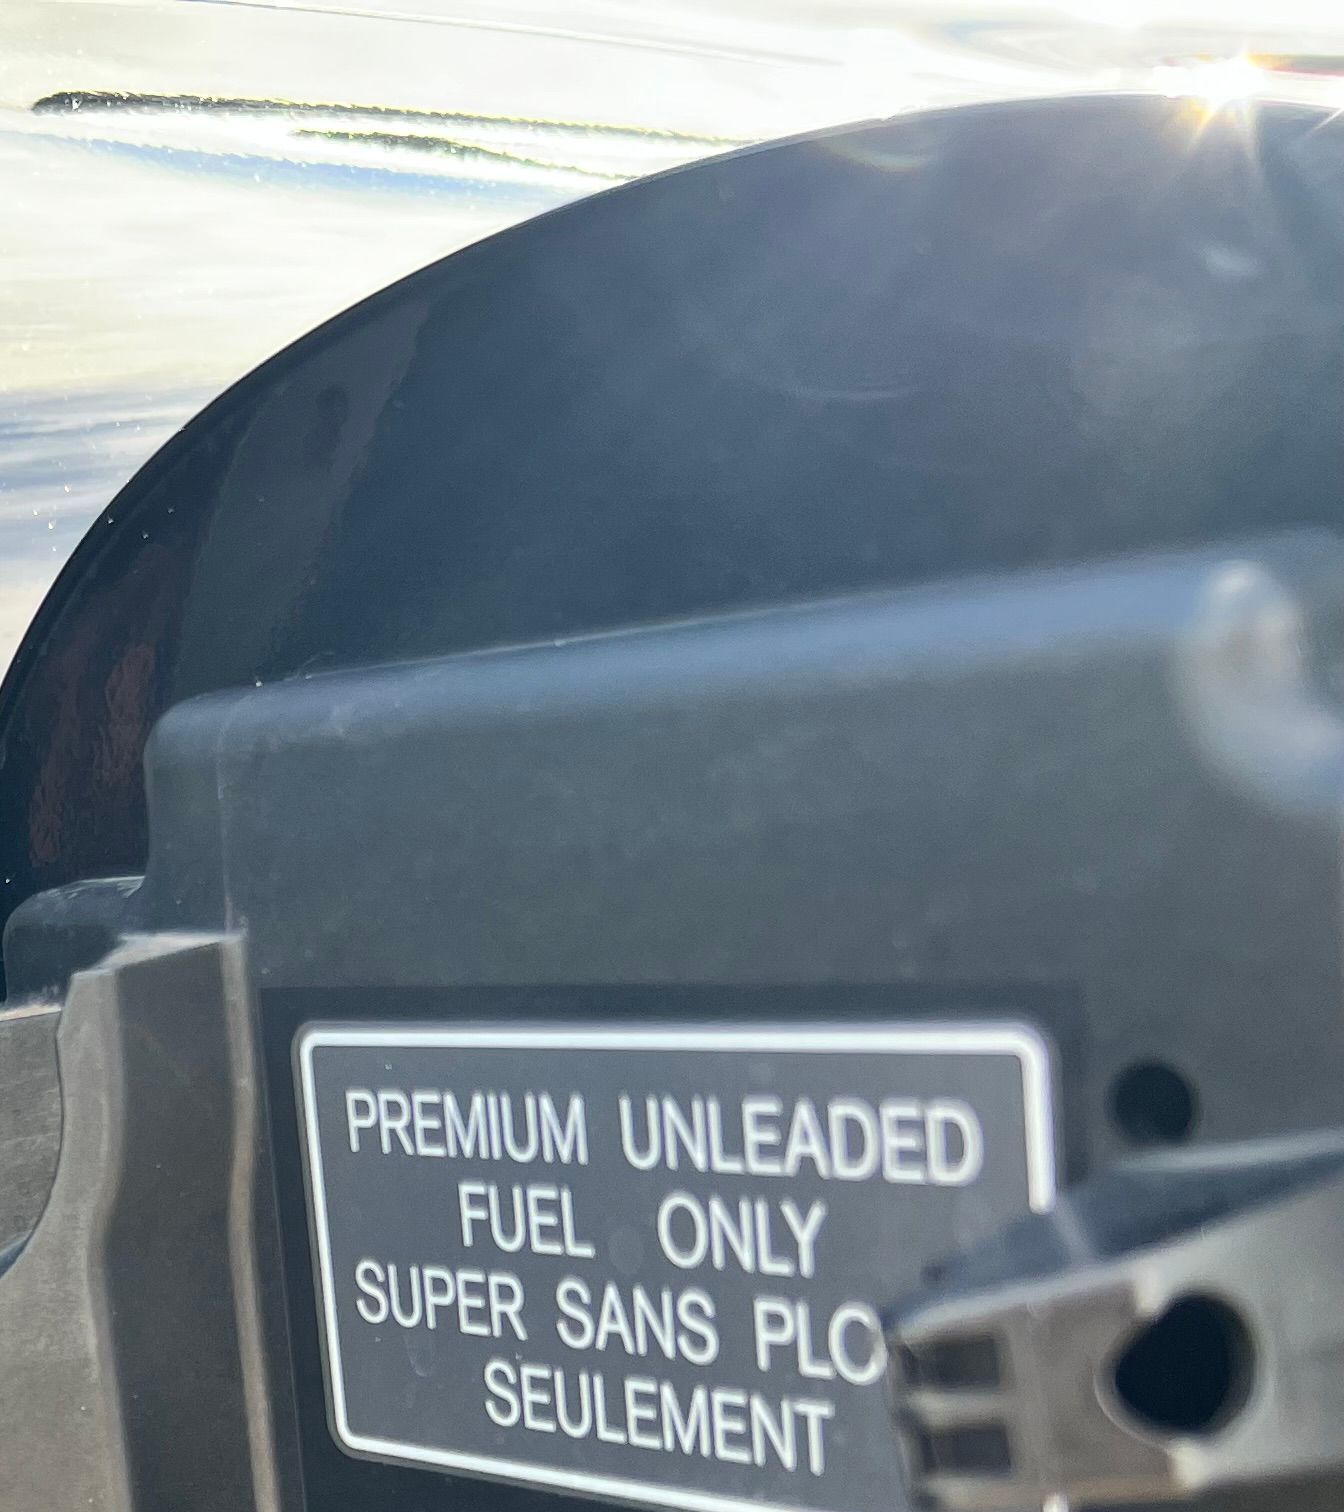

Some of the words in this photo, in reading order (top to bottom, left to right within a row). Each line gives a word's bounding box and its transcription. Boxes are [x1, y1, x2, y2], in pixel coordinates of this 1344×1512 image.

[345, 1089, 589, 1165] PREMIUM
[620, 1094, 984, 1186] UNLEADED
[458, 1182, 594, 1259] FUEL
[657, 1194, 827, 1279] ONLY
[354, 1261, 527, 1341] SUPER
[556, 1280, 719, 1366] SANS
[483, 1359, 833, 1476] SEULEMENT
